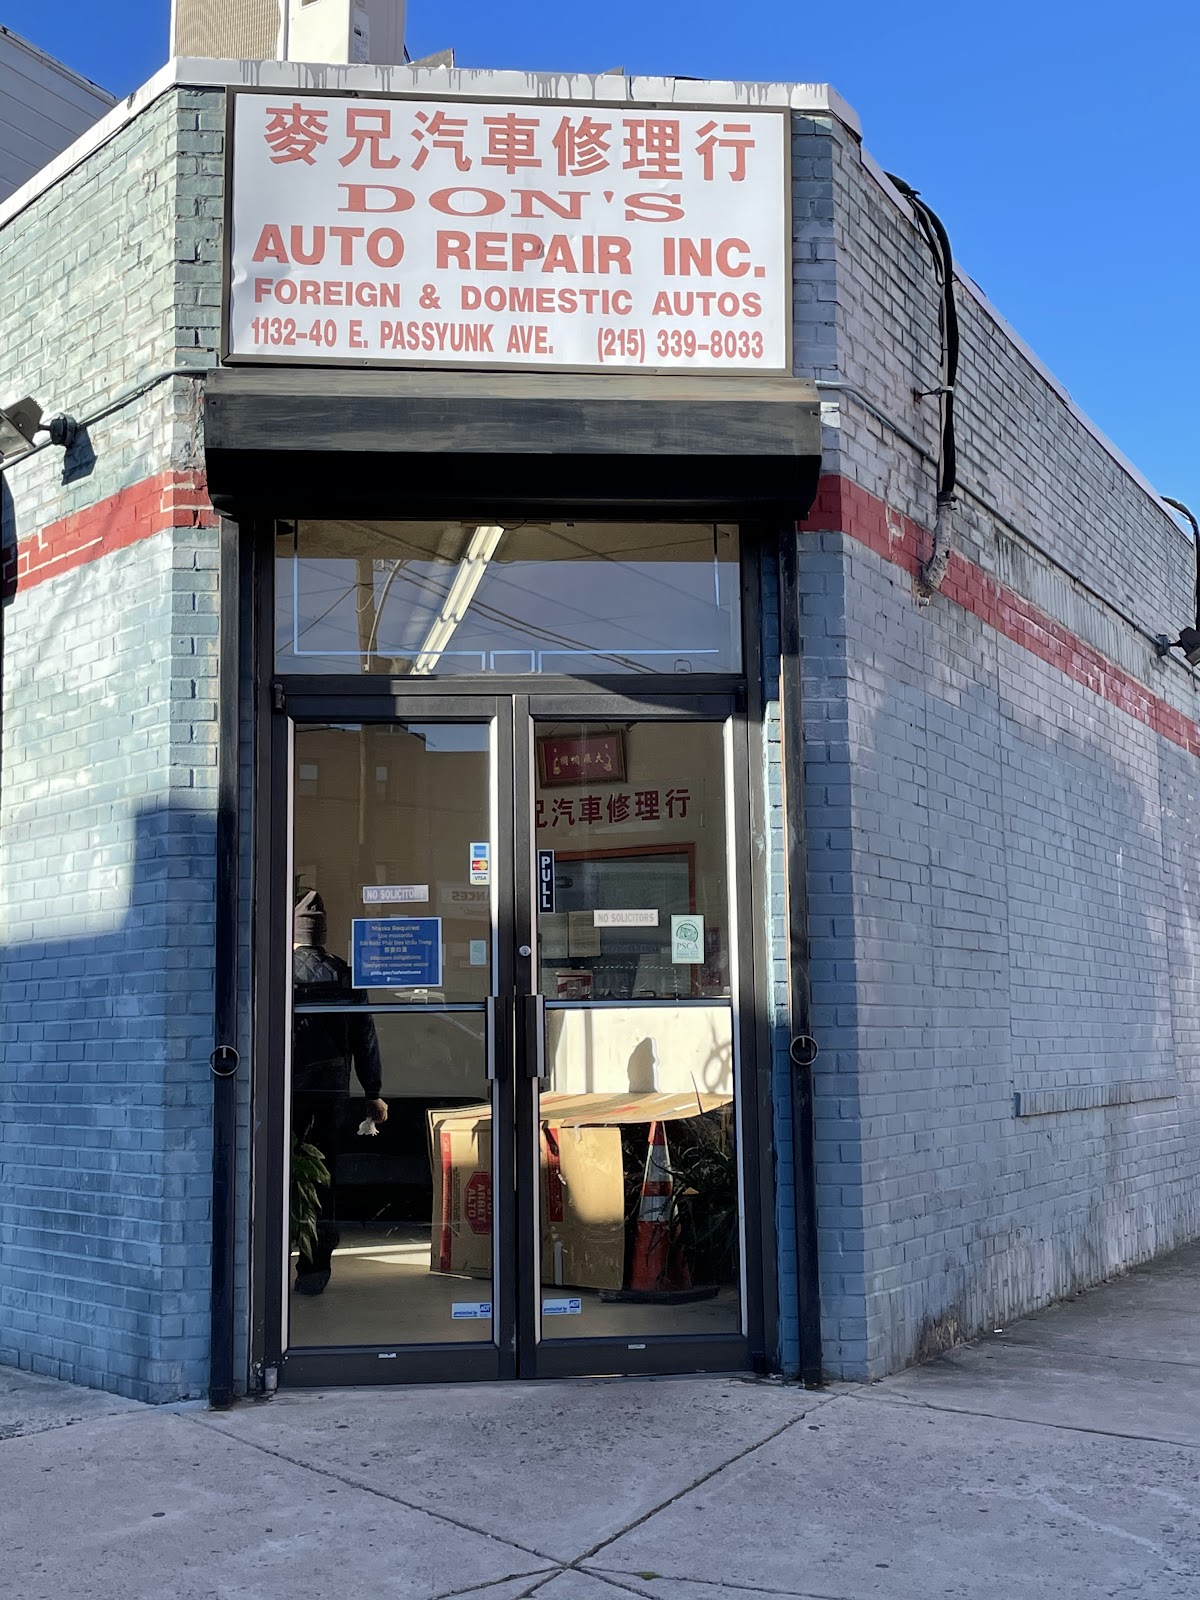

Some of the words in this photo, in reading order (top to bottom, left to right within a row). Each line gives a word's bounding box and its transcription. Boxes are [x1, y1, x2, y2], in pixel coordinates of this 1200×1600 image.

[263, 103, 756, 181] 麥兄汽車修理行
[337, 183, 685, 222] DON'S
[252, 224, 404, 268] AUTO
[436, 230, 632, 275] REPAIR
[663, 237, 766, 278] INC.
[254, 278, 400, 308] FOREIGN
[419, 284, 441, 310] &
[461, 285, 633, 315] DOMESTIC
[651, 291, 762, 318] AUTOS
[251, 317, 337, 347] 1132-40
[349, 320, 368, 348] E.
[380, 321, 494, 353] PASSYUNK
[507, 325, 554, 354] AVE.
[597, 327, 646, 363] (215)
[657, 329, 764, 359] 339-8033
[366, 889, 378, 900] NO
[541, 856, 551, 908] PULL
[598, 914, 609, 923] NO
[611, 913, 654, 922] SOLICITORS
[676, 942, 699, 950] PSCA
[468, 1188, 477, 1218] ALTO
